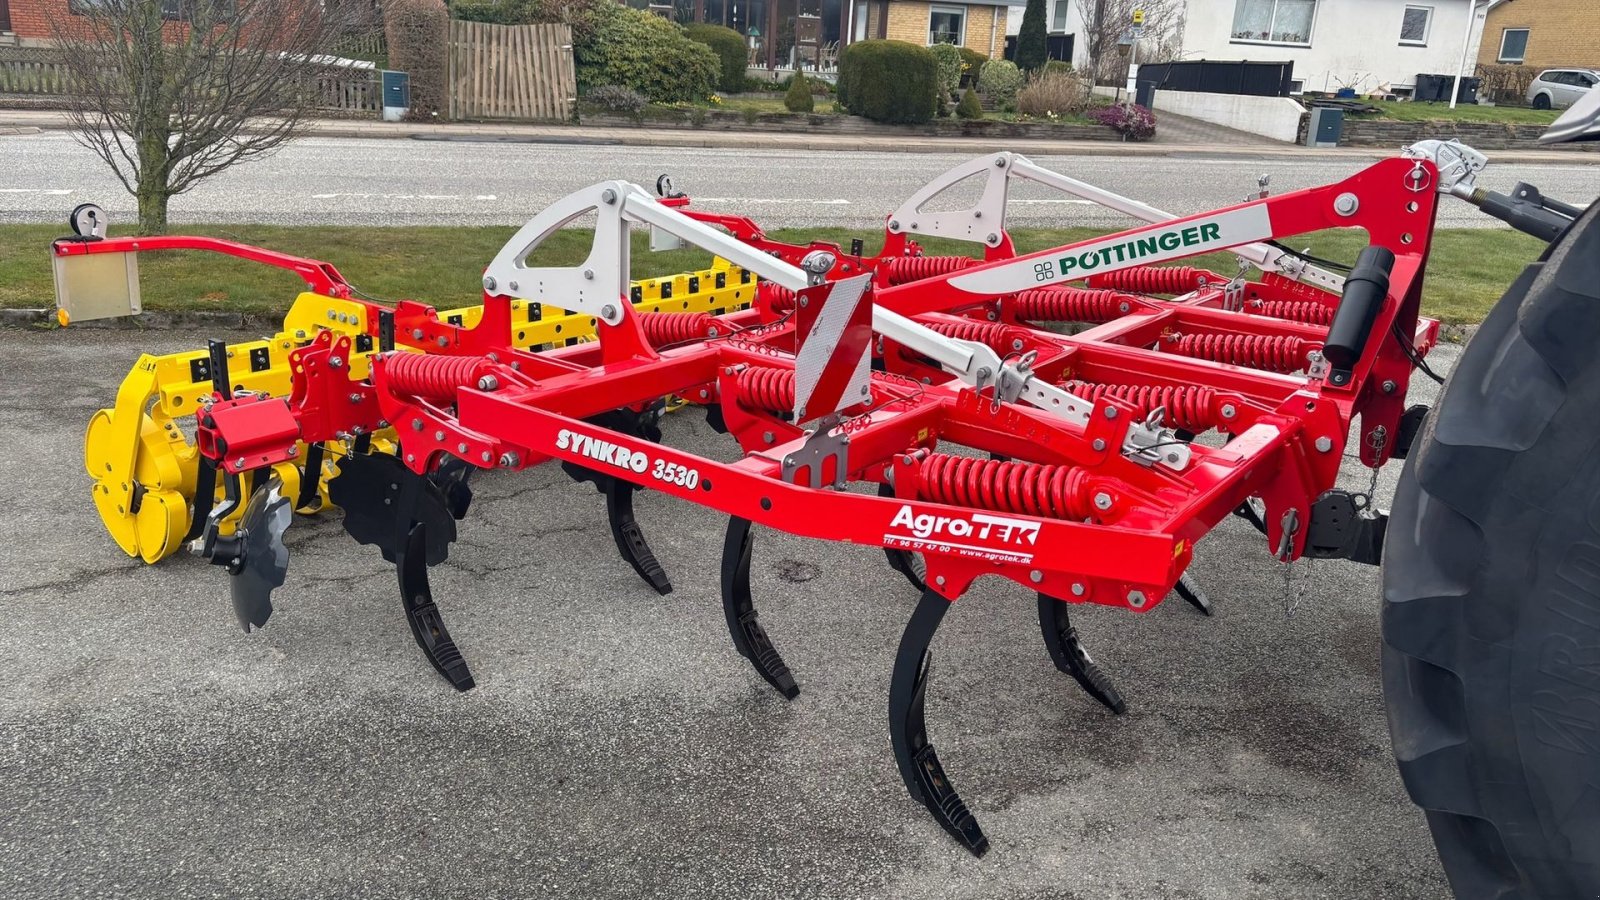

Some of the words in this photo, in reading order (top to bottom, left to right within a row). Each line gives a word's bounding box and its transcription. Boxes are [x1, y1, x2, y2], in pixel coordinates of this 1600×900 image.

[1059, 222, 1221, 275] PÖTTINGER
[555, 428, 649, 473] SYNKRO
[652, 459, 699, 490] 3530
[889, 504, 1042, 545] AgroTEK
[900, 540, 910, 548] 96
[913, 541, 924, 549] 57
[939, 545, 951, 553] 00
[959, 548, 1032, 565] www.agrotek.dk
